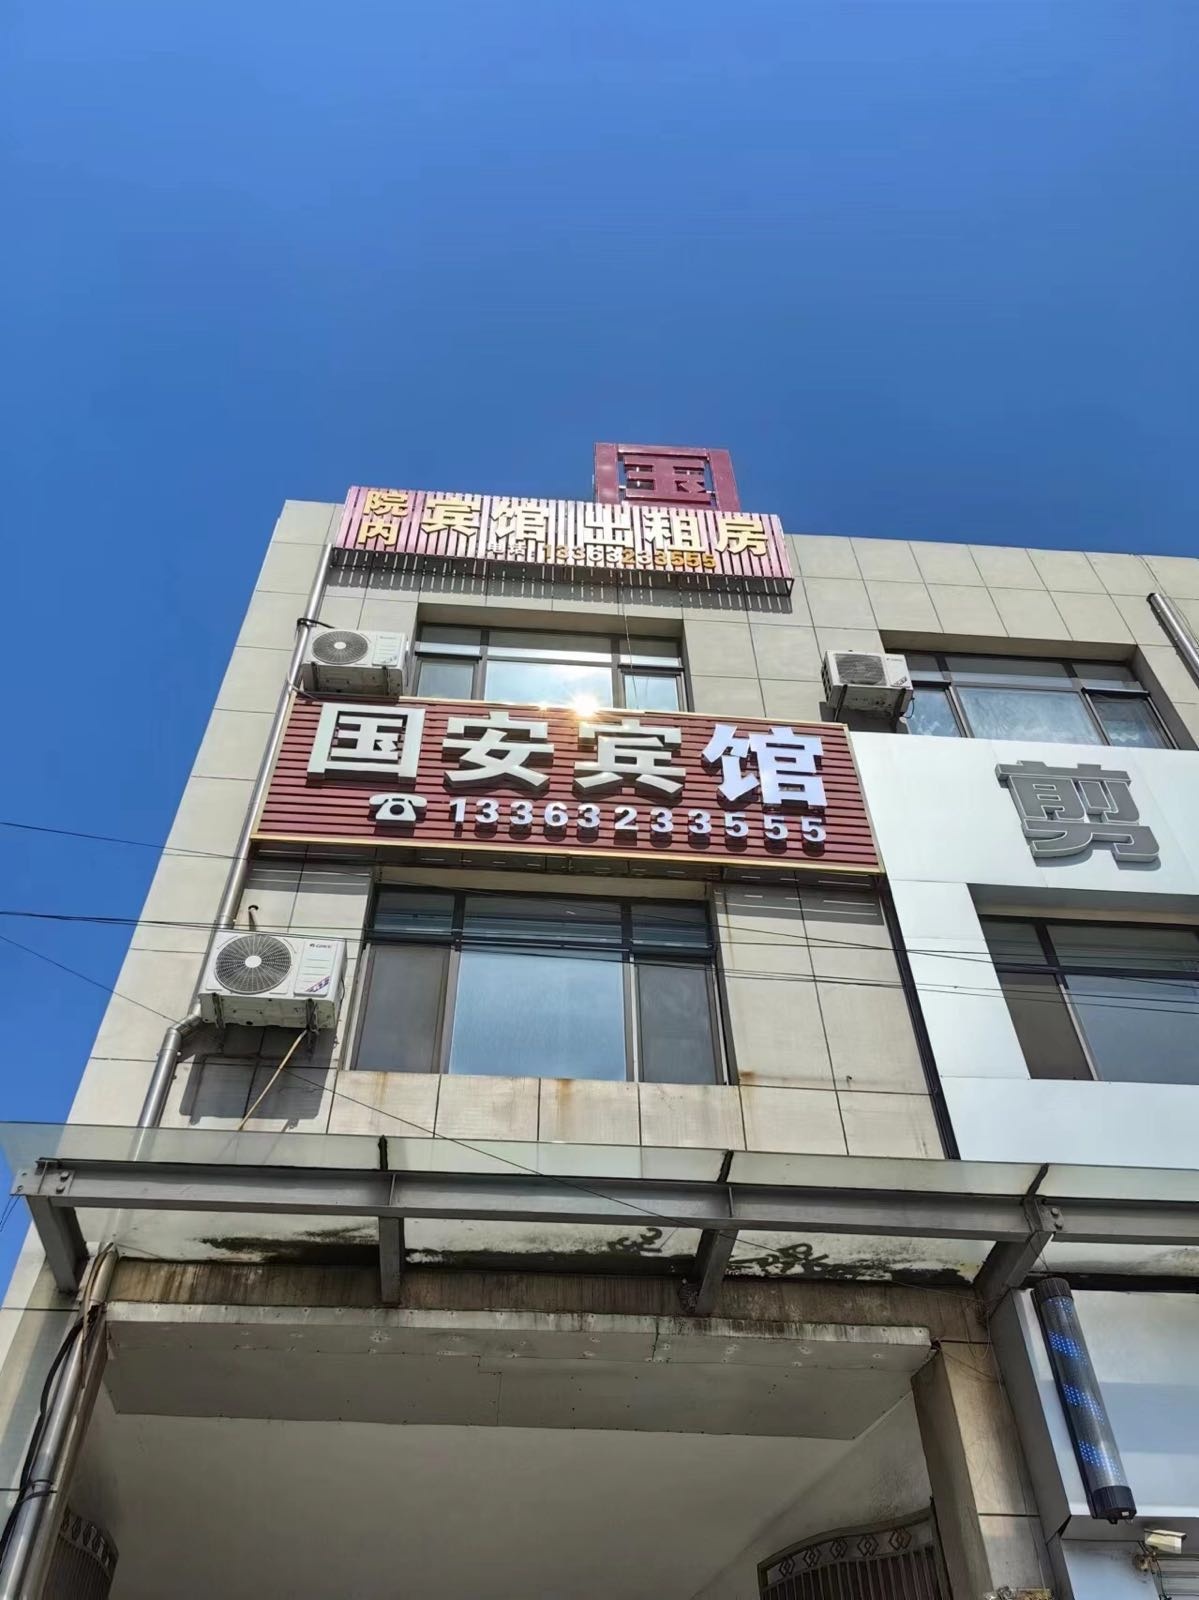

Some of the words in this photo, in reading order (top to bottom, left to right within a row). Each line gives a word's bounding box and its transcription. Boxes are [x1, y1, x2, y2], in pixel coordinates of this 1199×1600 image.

[358, 490, 408, 546] 院内
[421, 496, 768, 557] 宾馆出租房
[307, 702, 828, 808] 国安宾馆
[449, 797, 828, 846] 13363233555
[995, 760, 1160, 864] 剪
